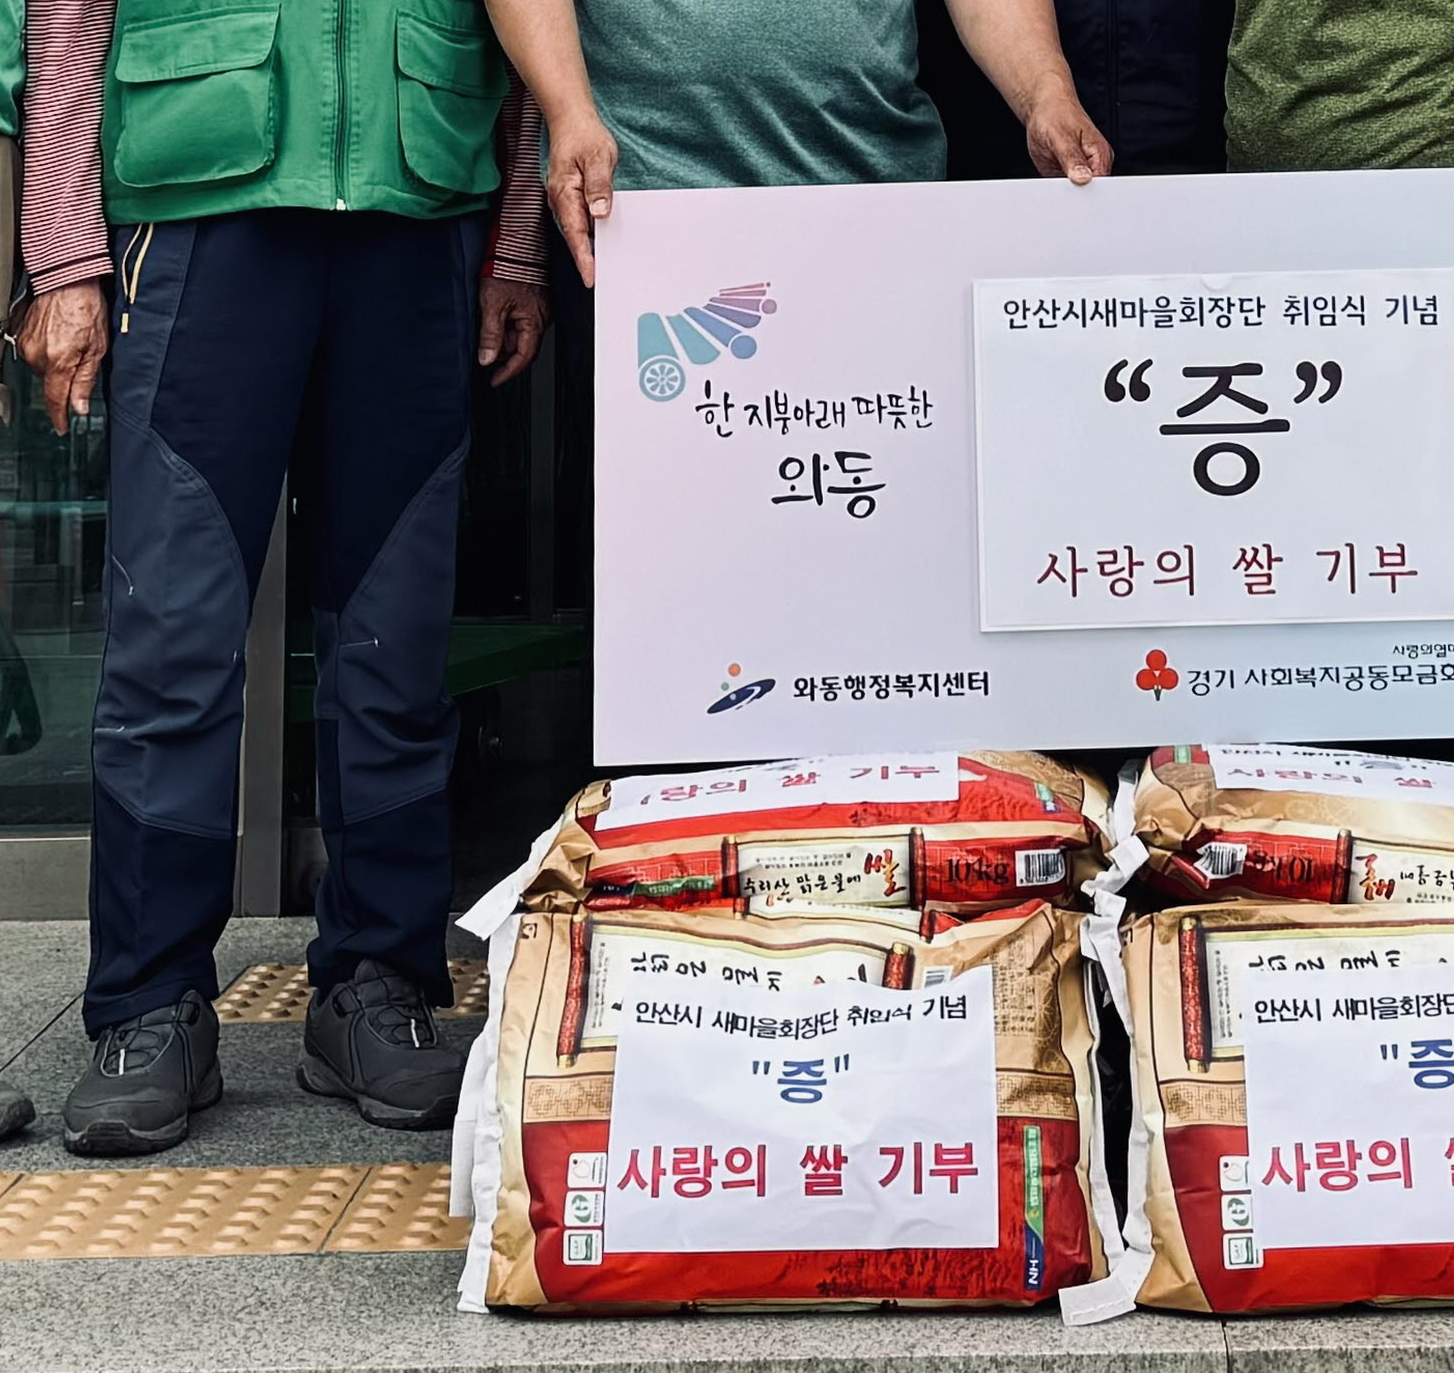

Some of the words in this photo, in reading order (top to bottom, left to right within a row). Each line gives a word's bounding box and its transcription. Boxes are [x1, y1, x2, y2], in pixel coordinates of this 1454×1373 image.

[1003, 295, 1267, 330] 안산시새마을회장단
[1282, 295, 1366, 327] 취임식
[1385, 294, 1438, 326] 기념
[694, 379, 735, 438] 한
[850, 385, 934, 430] 따뜻한
[770, 450, 887, 519] 와동
[1036, 544, 1195, 598] 사랑의
[1232, 543, 1284, 595] 쌀
[1315, 542, 1419, 595] 기부
[793, 670, 989, 702] 와동행정복지센터
[1187, 669, 1235, 697] 경기
[635, 1001, 703, 1029] 안산시
[711, 1008, 840, 1041] 새마을회장단
[922, 994, 967, 1020] 기념
[1254, 998, 1322, 1024] 안산시
[616, 1144, 767, 1199] 사랑의
[799, 1144, 849, 1197] 쌀
[878, 1141, 979, 1195] 기부
[1261, 1137, 1413, 1193] 사랑의
